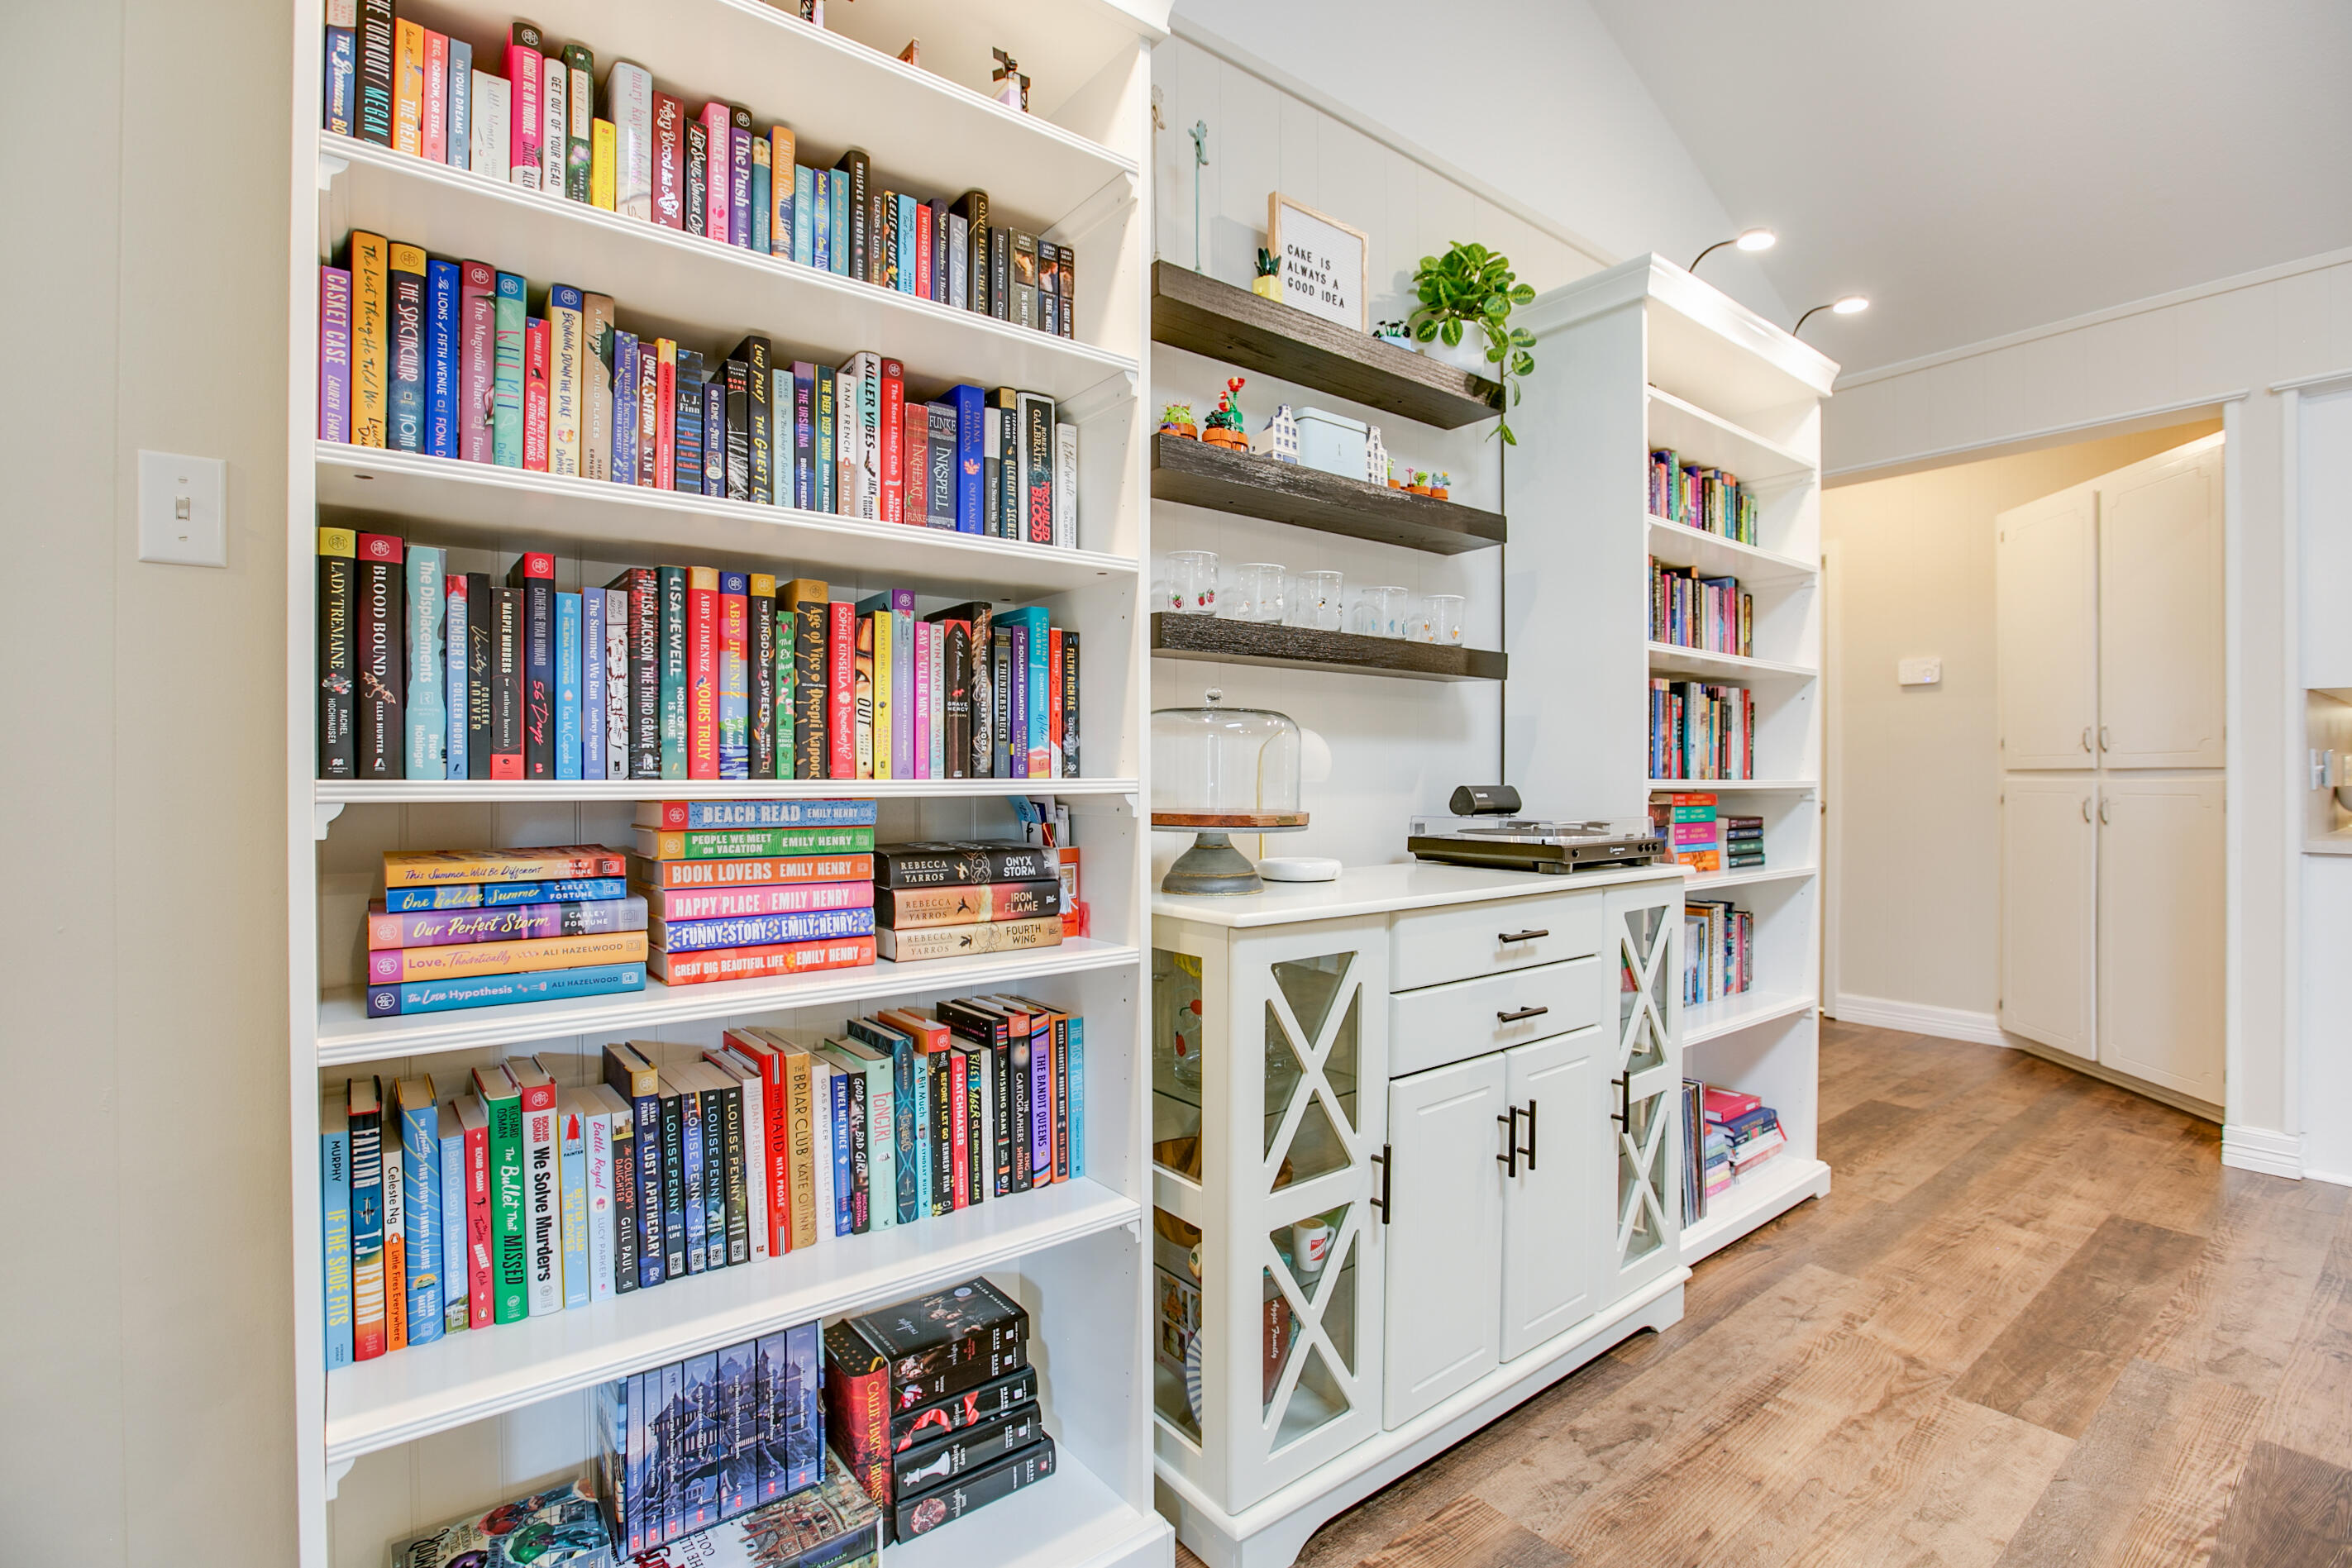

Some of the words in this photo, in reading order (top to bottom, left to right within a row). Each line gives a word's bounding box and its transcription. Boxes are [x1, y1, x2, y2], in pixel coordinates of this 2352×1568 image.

[365, 18, 390, 79] TURNOUT
[432, 39, 441, 57] BEG,
[430, 59, 441, 98] BORROW,
[456, 59, 464, 69] IN
[456, 71, 465, 97] YOUR
[551, 76, 561, 96] GET
[365, 86, 389, 136] MEGAN
[431, 100, 440, 113] OR
[455, 98, 464, 135] DREAMS
[551, 98, 561, 116] OUT
[430, 114, 440, 138] STEAL
[551, 118, 561, 132] OF
[550, 135, 561, 159] YOUR
[735, 135, 750, 165] The
[550, 161, 560, 187] HEAD
[735, 170, 749, 207] Push
[921, 217, 929, 257] WINDSOR
[1288, 244, 1312, 263] CAKE
[1321, 258, 1330, 270] IS
[1287, 260, 1326, 284] ALWAYS
[1333, 279, 1338, 289] A
[327, 274, 346, 326] CASKET
[399, 283, 418, 303] THE
[1288, 277, 1314, 296] GOOD
[1322, 291, 1344, 308] IDEA
[475, 302, 486, 321] The
[326, 329, 345, 365] CASE
[398, 304, 418, 382] SPECTACULAR
[470, 324, 485, 371] Magnolia
[474, 375, 485, 409] Palace
[866, 360, 875, 407] KILLER
[866, 409, 875, 449] VIBES
[929, 415, 956, 431] FUNKE
[1031, 486, 1042, 541] BLOOD
[1042, 482, 1050, 541] TROUBLED
[331, 561, 345, 597] LADY
[420, 561, 435, 584] The
[373, 565, 387, 618] BLOOD
[670, 576, 681, 612] LISA
[502, 602, 513, 633] MAGPIE
[589, 598, 600, 617] The
[331, 598, 345, 670] TREMAINE
[420, 588, 435, 683] Displacements
[451, 596, 466, 656] NOVEMBER
[838, 607, 847, 640] SOPHIE
[373, 622, 387, 676] BOUND
[589, 618, 599, 660] Summer
[670, 617, 681, 676] JEWELL
[451, 661, 465, 670] 9
[501, 635, 512, 674] MURDERS
[838, 642, 848, 689] KINSELLA
[589, 662, 599, 678] We
[453, 683, 463, 718] COLLEEN
[589, 680, 599, 700] Ran
[697, 683, 711, 723] YOURS
[857, 698, 871, 727] OUT
[453, 721, 463, 755] HOOVER
[697, 725, 710, 760] TRULY
[703, 806, 755, 823] BEACH
[761, 805, 800, 822] READ
[807, 808, 831, 818] EMILY
[833, 808, 858, 817] HENRY
[692, 835, 728, 844] PEOPLE
[731, 835, 745, 843] WE
[748, 834, 771, 843] MEET
[782, 836, 813, 846] EMILY
[818, 836, 852, 846] HENRY
[717, 845, 762, 854] VACATION
[672, 865, 713, 883] BOOK
[718, 863, 771, 881] LOVERS
[780, 863, 813, 877] EMILY
[818, 861, 852, 875] HENRY
[901, 860, 947, 870] REBECCA
[1004, 865, 1036, 876] STORM
[1005, 856, 1033, 866] ONYX
[554, 884, 589, 892] CARLEY
[905, 874, 944, 882] YARROS
[402, 893, 430, 909] One
[433, 892, 484, 908] Golden
[488, 888, 541, 903] Summer
[550, 891, 593, 900] FORTUNE
[675, 897, 718, 917] HAPPY
[722, 894, 760, 913] PLACE
[771, 892, 807, 909] EMILY
[813, 889, 849, 907] HENRY
[1004, 901, 1038, 913] FLAME
[1010, 892, 1032, 901] IRON
[413, 922, 441, 937] Our
[447, 915, 499, 936] Perfect
[500, 913, 550, 933] Storm
[564, 917, 608, 927] FORTUNE
[682, 925, 724, 945] FUNNY
[728, 922, 767, 941] STORY
[782, 918, 815, 937] EMILY
[819, 916, 853, 934] HENRY
[1005, 924, 1041, 936] FOURTH
[1012, 933, 1036, 943] WING
[408, 958, 446, 969] Love,
[446, 951, 511, 967] Theoretically
[543, 948, 559, 956] ALI
[561, 944, 623, 955] HAZELWOOD
[675, 964, 701, 975] GREAT
[704, 963, 718, 973] BIG
[721, 958, 764, 971] BEAUTIFUL
[767, 956, 784, 966] LIFE
[796, 951, 825, 965] EMILY
[829, 946, 859, 960] HENRY
[408, 994, 421, 1003] the
[422, 989, 446, 1004] Love
[449, 985, 512, 999] Hypothesis
[567, 976, 618, 987] HAZELWOOD
[1037, 1075, 1046, 1108] BANDIT
[956, 1075, 965, 1146] MATCHMAKER
[593, 1121, 605, 1154] Battle
[666, 1114, 676, 1165] LOUISE
[1038, 1111, 1047, 1147] QUEENS
[352, 1127, 380, 1188] FALLING
[504, 1147, 514, 1161] The
[533, 1146, 550, 1170] We
[388, 1166, 399, 1205] Celeste
[501, 1165, 520, 1208] Bullet
[593, 1157, 606, 1189] Royal
[533, 1173, 551, 1213] Solve
[668, 1168, 679, 1216] PENNY
[327, 1209, 346, 1222] IF
[387, 1207, 400, 1224] Ng
[503, 1213, 518, 1231] That
[644, 1181, 660, 1258] APOTHECARY
[327, 1225, 347, 1254] THE
[536, 1216, 554, 1282] Murders
[391, 1250, 399, 1270] Little
[503, 1235, 524, 1285] MISSED
[328, 1256, 349, 1294] SHOE
[391, 1272, 400, 1290] Fires
[329, 1294, 349, 1327] FITS
